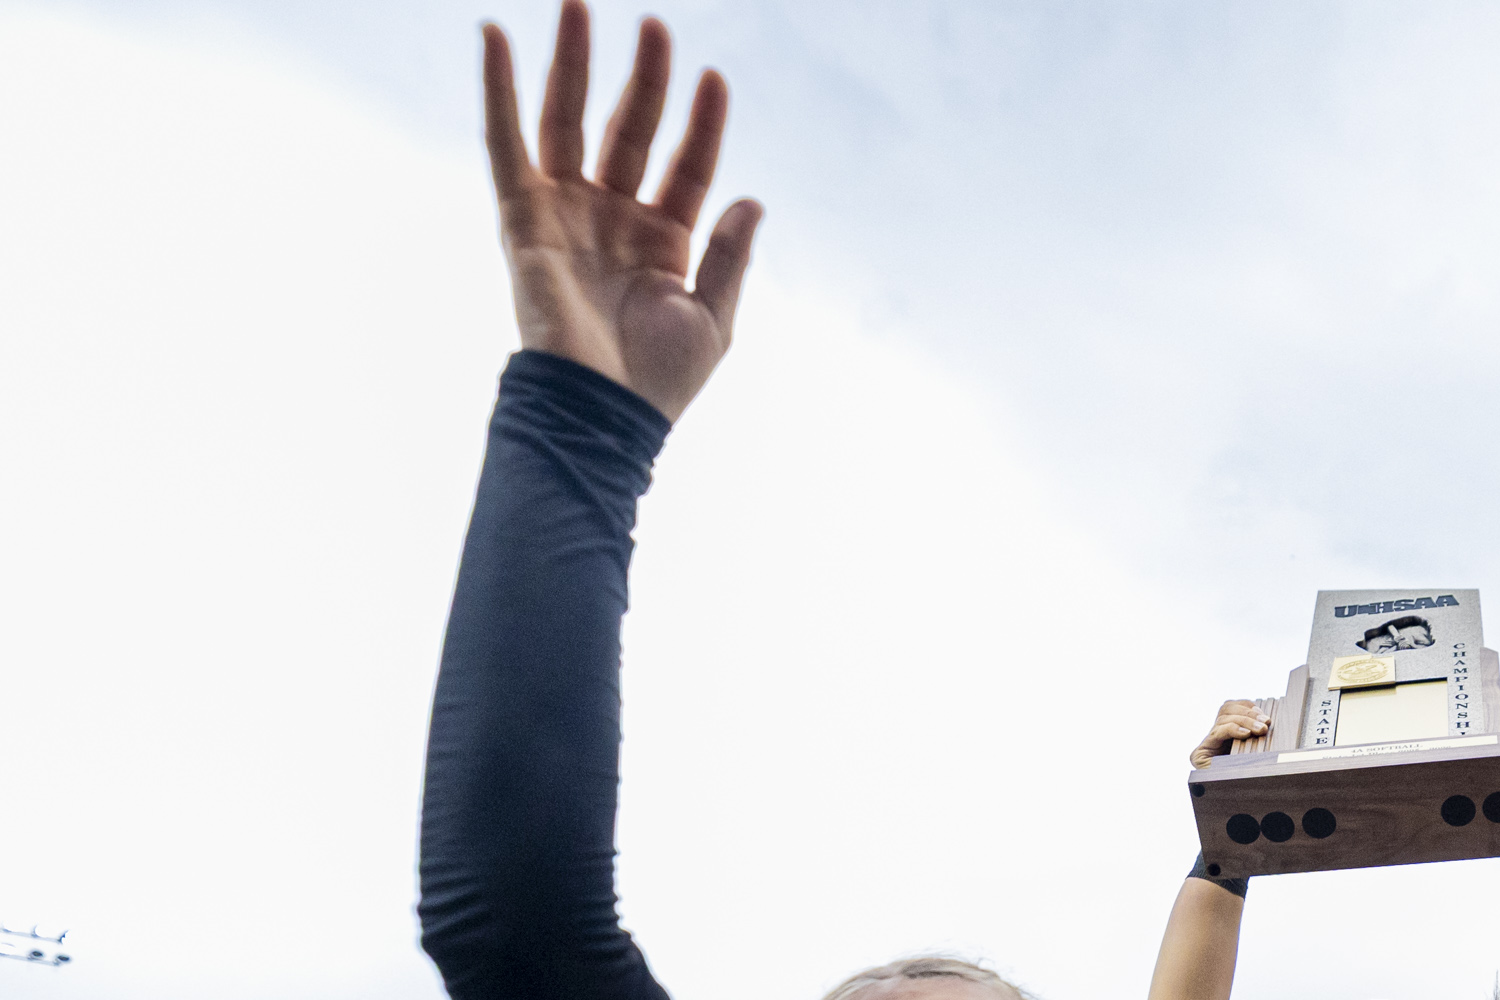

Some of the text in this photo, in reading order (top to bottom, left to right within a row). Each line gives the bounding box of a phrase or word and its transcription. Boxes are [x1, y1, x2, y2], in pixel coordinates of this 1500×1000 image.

[1334, 594, 1460, 618] UHSAA
[1453, 642, 1471, 735] CHAMPIONSH
[1315, 700, 1332, 745] STATE
[1366, 743, 1423, 753] SOFTBALL
